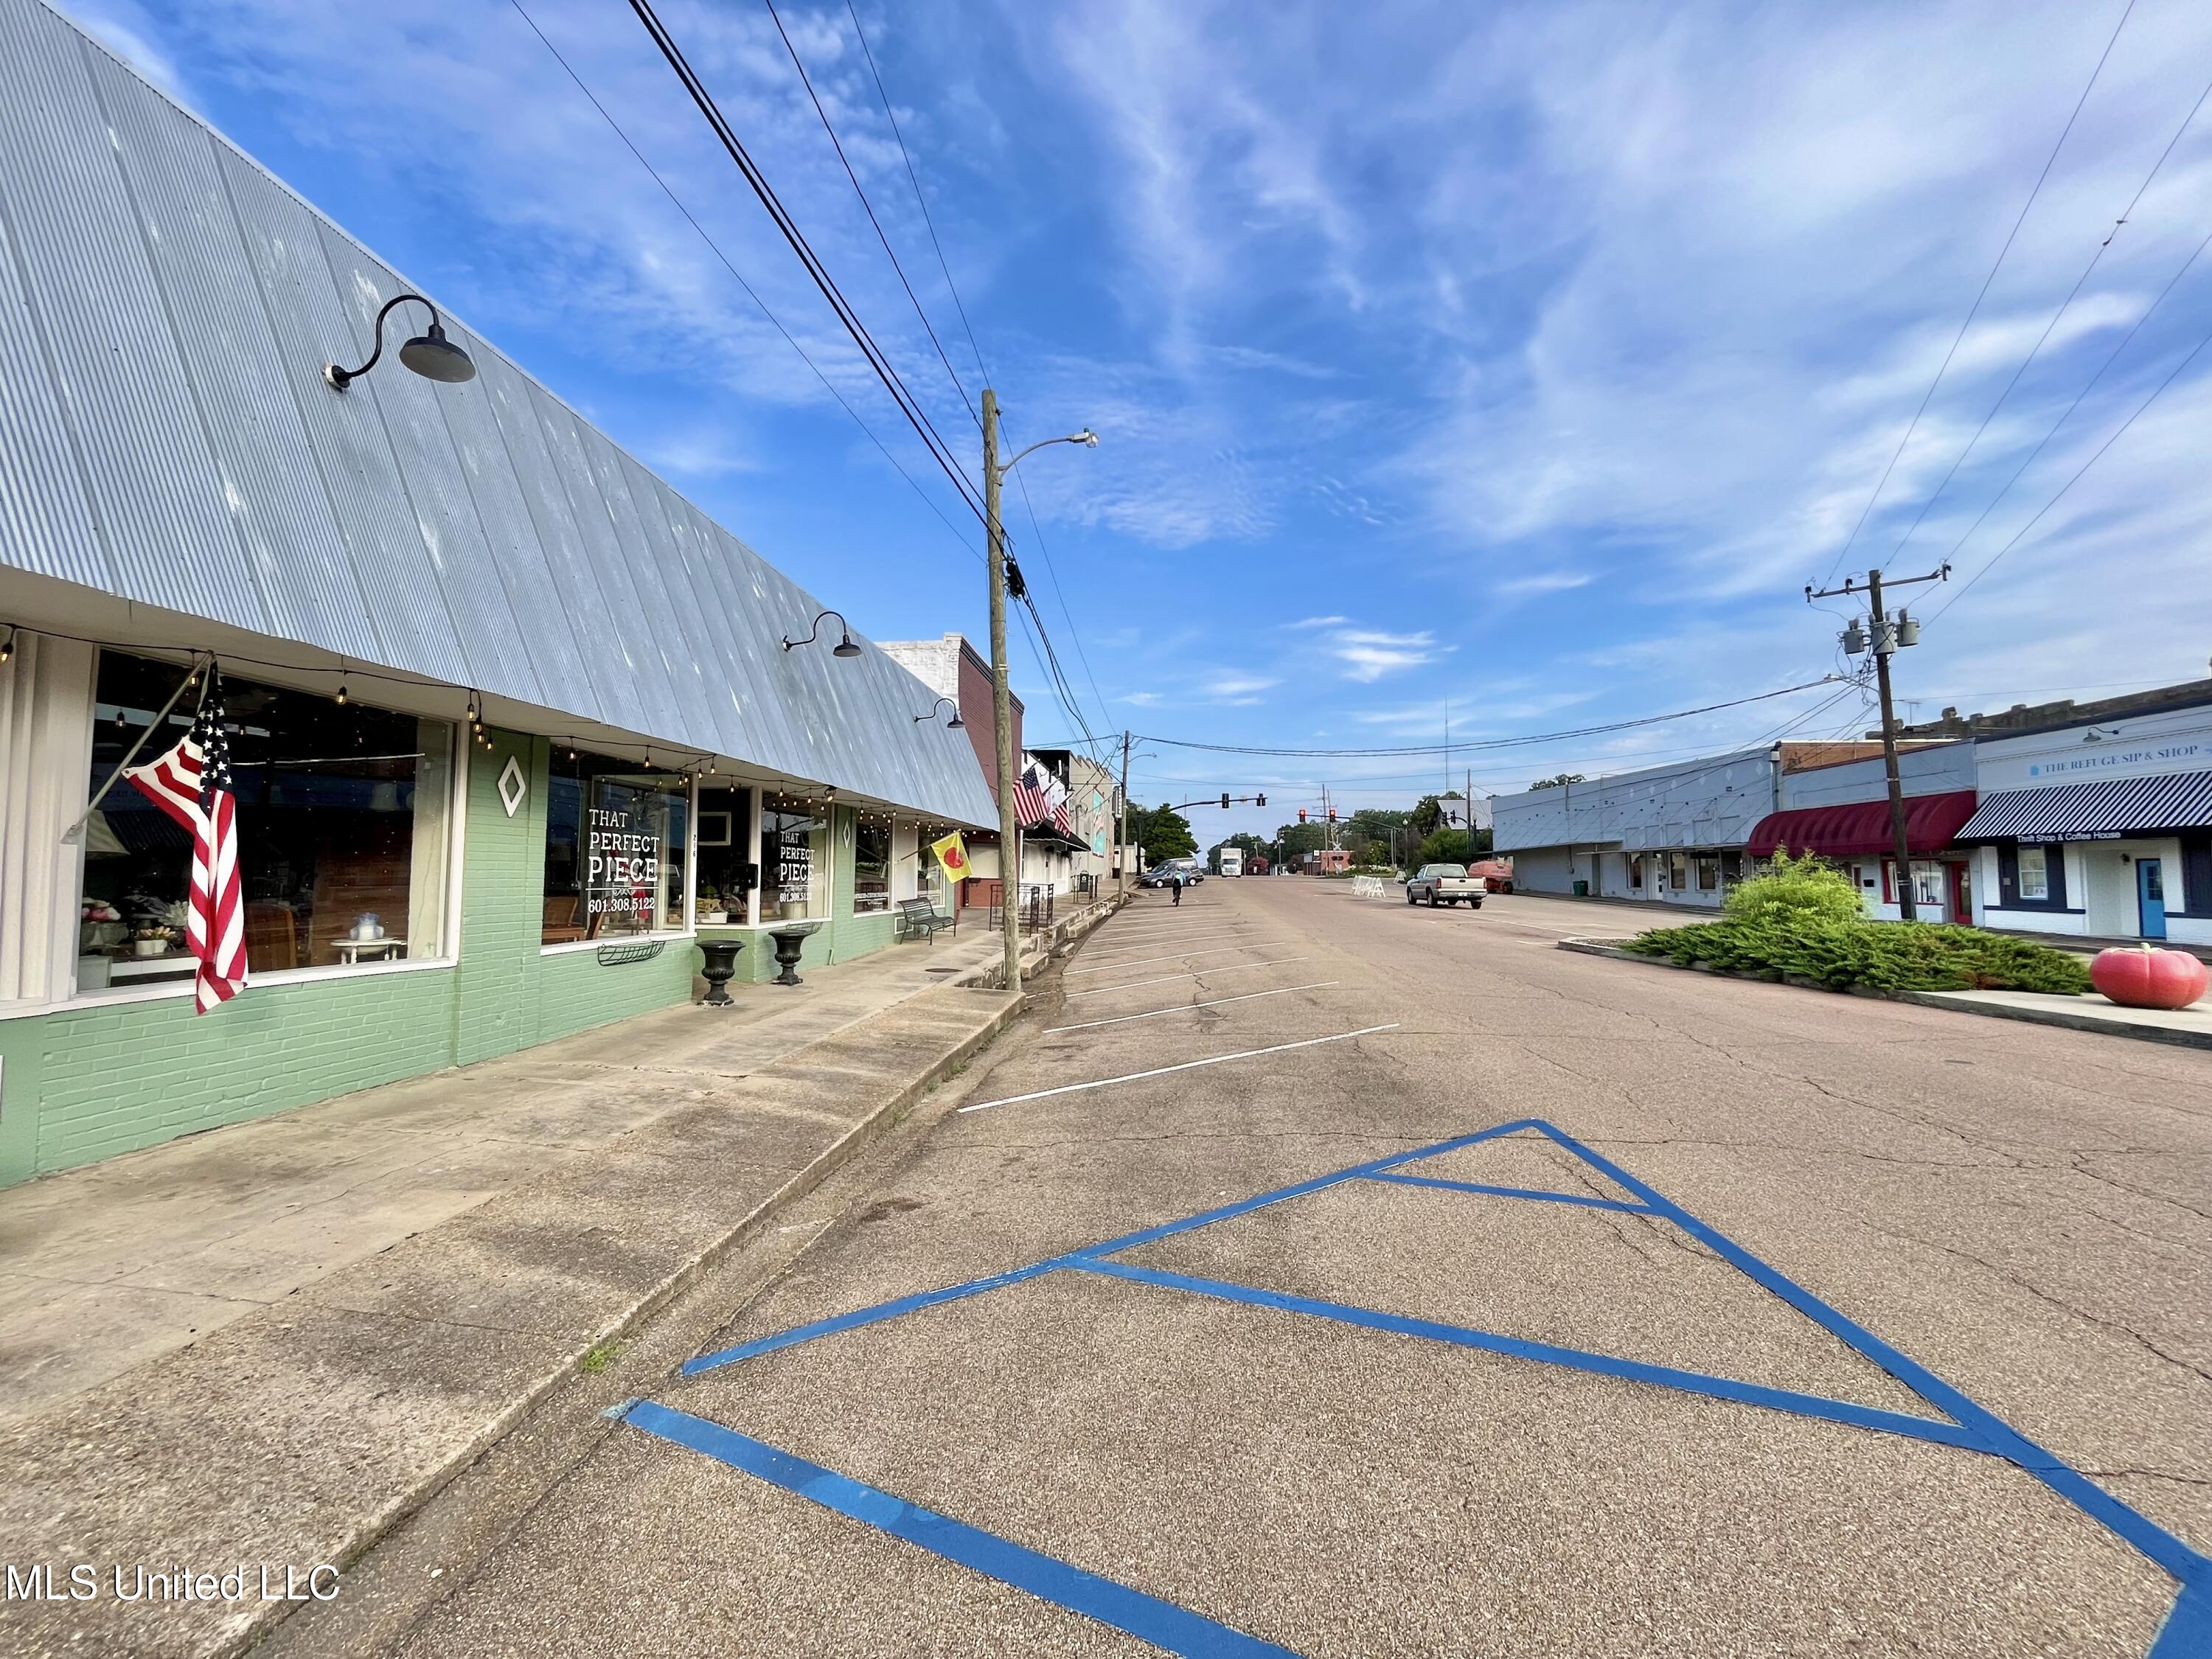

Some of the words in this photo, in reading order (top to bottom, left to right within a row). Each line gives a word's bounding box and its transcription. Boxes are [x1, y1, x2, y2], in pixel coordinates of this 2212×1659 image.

[2045, 762, 2067, 773] THE
[2071, 757, 2119, 770] REFUGE
[2121, 753, 2142, 763] SIP
[2144, 751, 2154, 760] &
[2157, 745, 2199, 758] SHOP
[588, 808, 628, 828] THAT
[589, 832, 661, 852] PERFECT
[780, 830, 800, 844] THAT
[2036, 834, 2056, 843] Shop
[2058, 833, 2064, 841] &
[2065, 832, 2092, 841] Coffee
[2093, 831, 2121, 839] House
[779, 846, 815, 861] PERFECT
[587, 856, 659, 883] PIECE
[779, 863, 815, 882] PIECE
[588, 897, 655, 914] 601.308.5122
